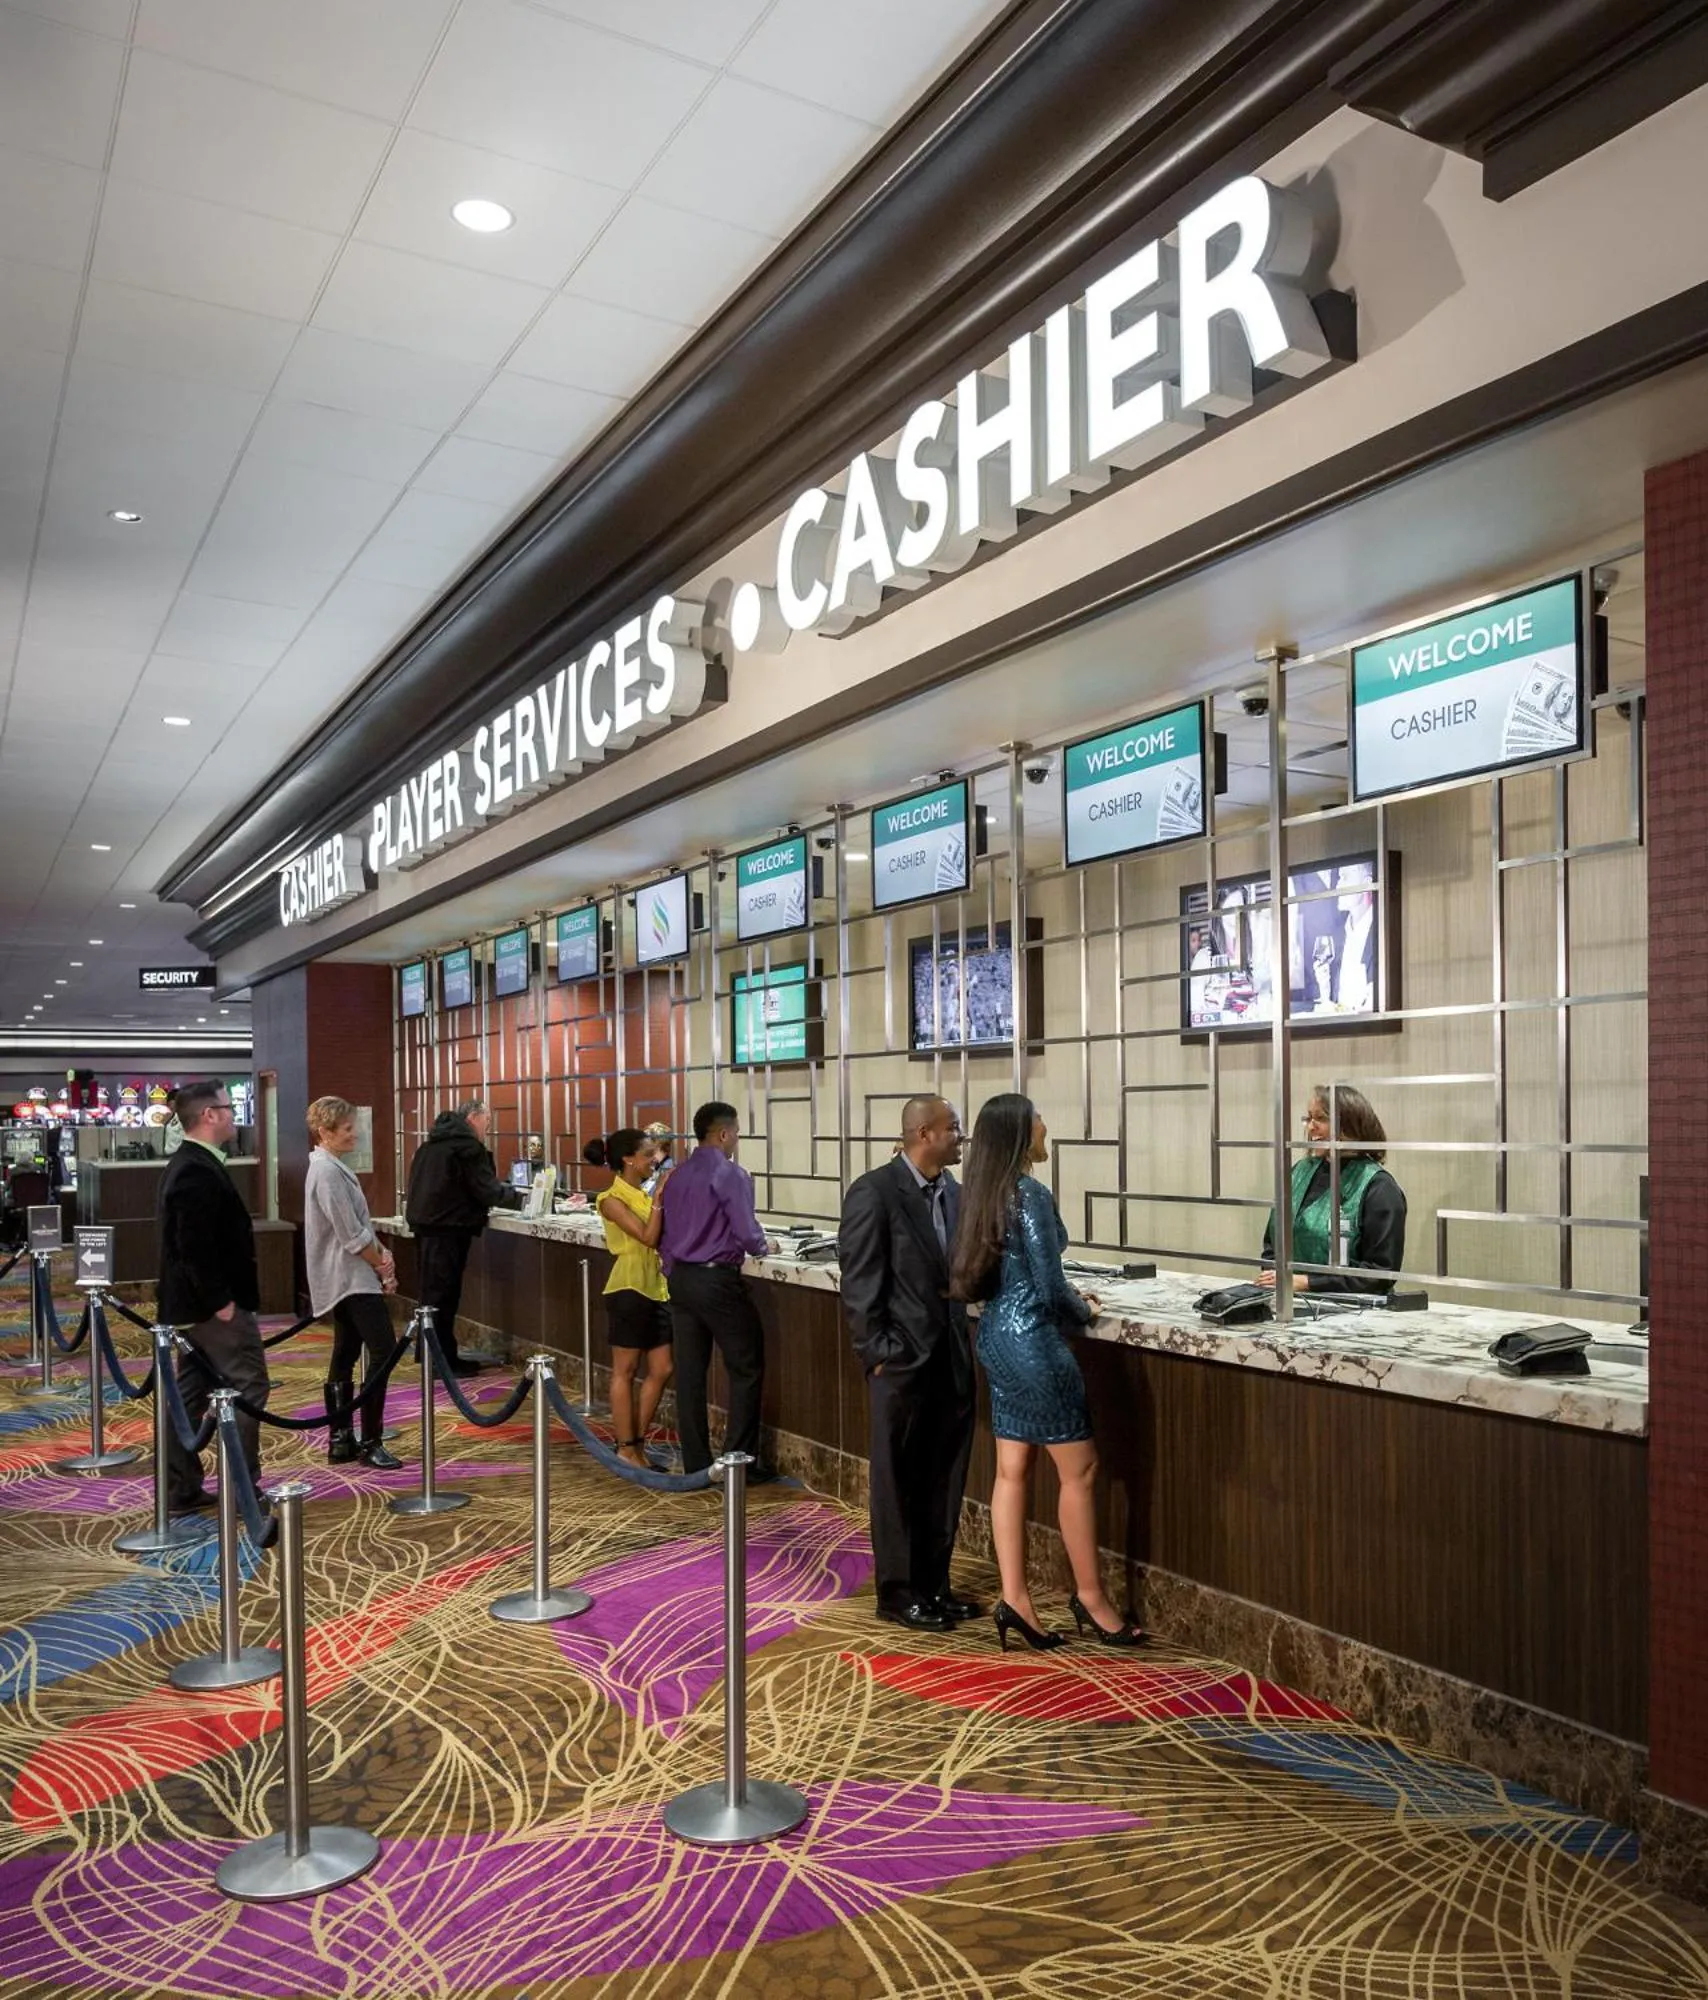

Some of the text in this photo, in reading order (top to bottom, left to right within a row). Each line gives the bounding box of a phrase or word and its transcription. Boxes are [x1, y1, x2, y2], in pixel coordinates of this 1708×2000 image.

[280, 175, 1290, 928] CASHIER PLAYER SERVICES CASHIER
[1388, 612, 1533, 680] WELCOME
[1390, 699, 1477, 740] CASHIER
[1086, 727, 1176, 774] WELCOME
[887, 799, 948, 833] WELCOME
[1088, 792, 1142, 821] CASHIER
[747, 848, 794, 875] WELCOME
[888, 850, 926, 873] CASHIER
[748, 892, 777, 911] CASHIER
[142, 971, 199, 984] SECURITY
